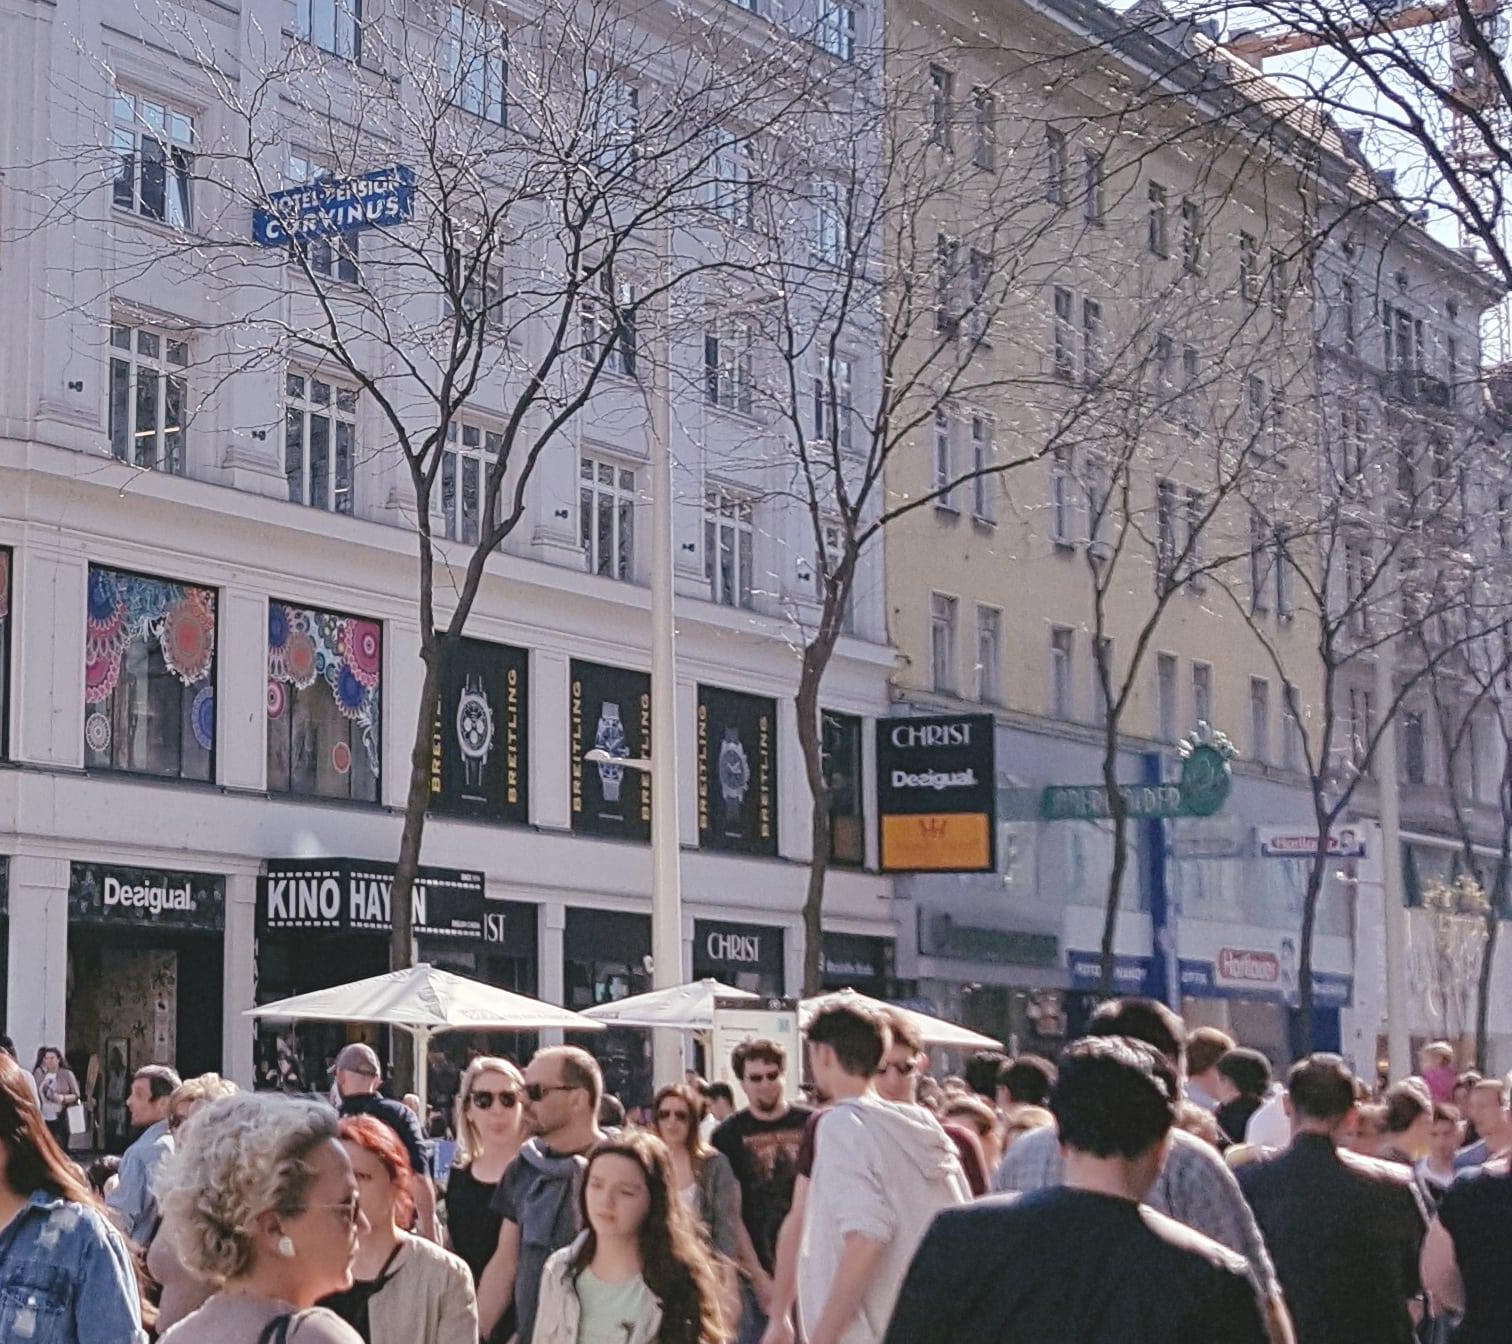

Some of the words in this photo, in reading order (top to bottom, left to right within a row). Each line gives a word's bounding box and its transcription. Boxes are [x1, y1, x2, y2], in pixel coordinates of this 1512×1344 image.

[507, 668, 518, 804] BREITLING
[571, 680, 582, 813] BREITLING
[640, 692, 651, 822] BRETLING
[698, 704, 709, 830] BREITLING
[759, 715, 771, 838] BREITLING
[891, 723, 972, 748] CHRIST
[891, 768, 976, 790] Desigual
[268, 879, 341, 920] KINO
[350, 880, 427, 925] HAYN
[707, 932, 760, 962] CHRIST
